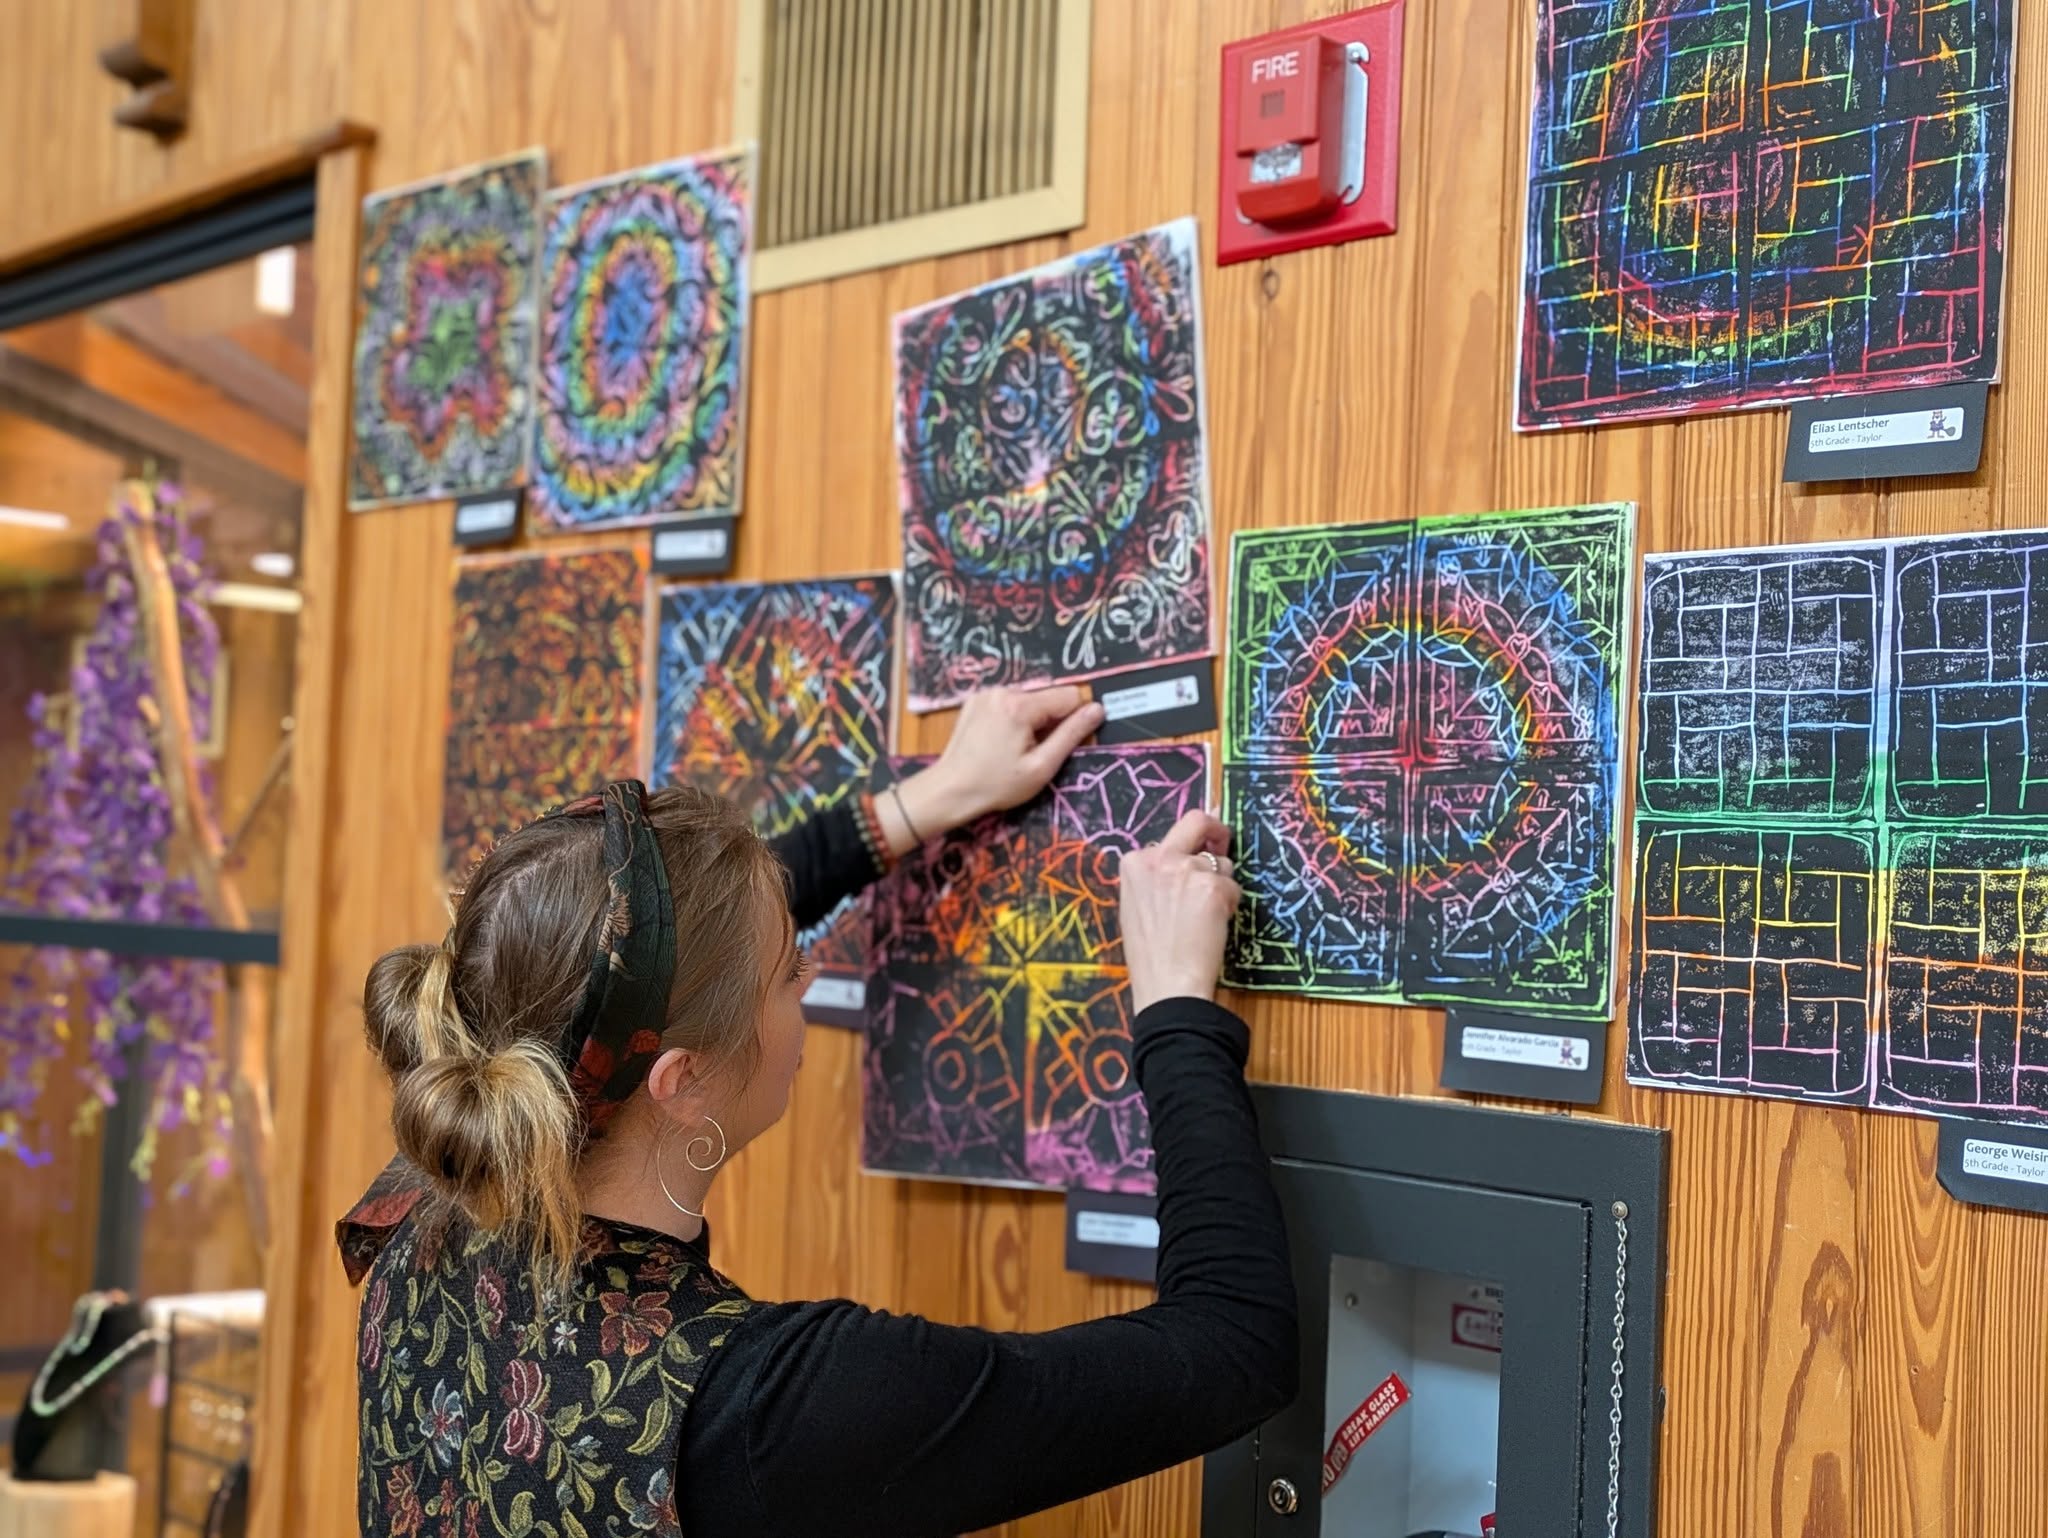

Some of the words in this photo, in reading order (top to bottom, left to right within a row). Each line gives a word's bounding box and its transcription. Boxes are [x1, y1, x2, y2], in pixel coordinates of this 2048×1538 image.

[1251, 51, 1300, 84] FIRE
[1812, 423, 1836, 434] Elias
[1838, 418, 1890, 432] Lentscher
[1825, 436, 1850, 447] Grade
[1857, 433, 1883, 444] Taylor
[1498, 1034, 1532, 1044] Alvarado
[1966, 1142, 2009, 1159] George
[1964, 1159, 1979, 1168] 5th
[1981, 1160, 2009, 1172] Grade
[2016, 1164, 2046, 1177] Taylor
[1341, 1409, 1368, 1440] BREAK
[1368, 1382, 1396, 1412] GLASS
[1365, 1393, 1400, 1431] HANDLE
